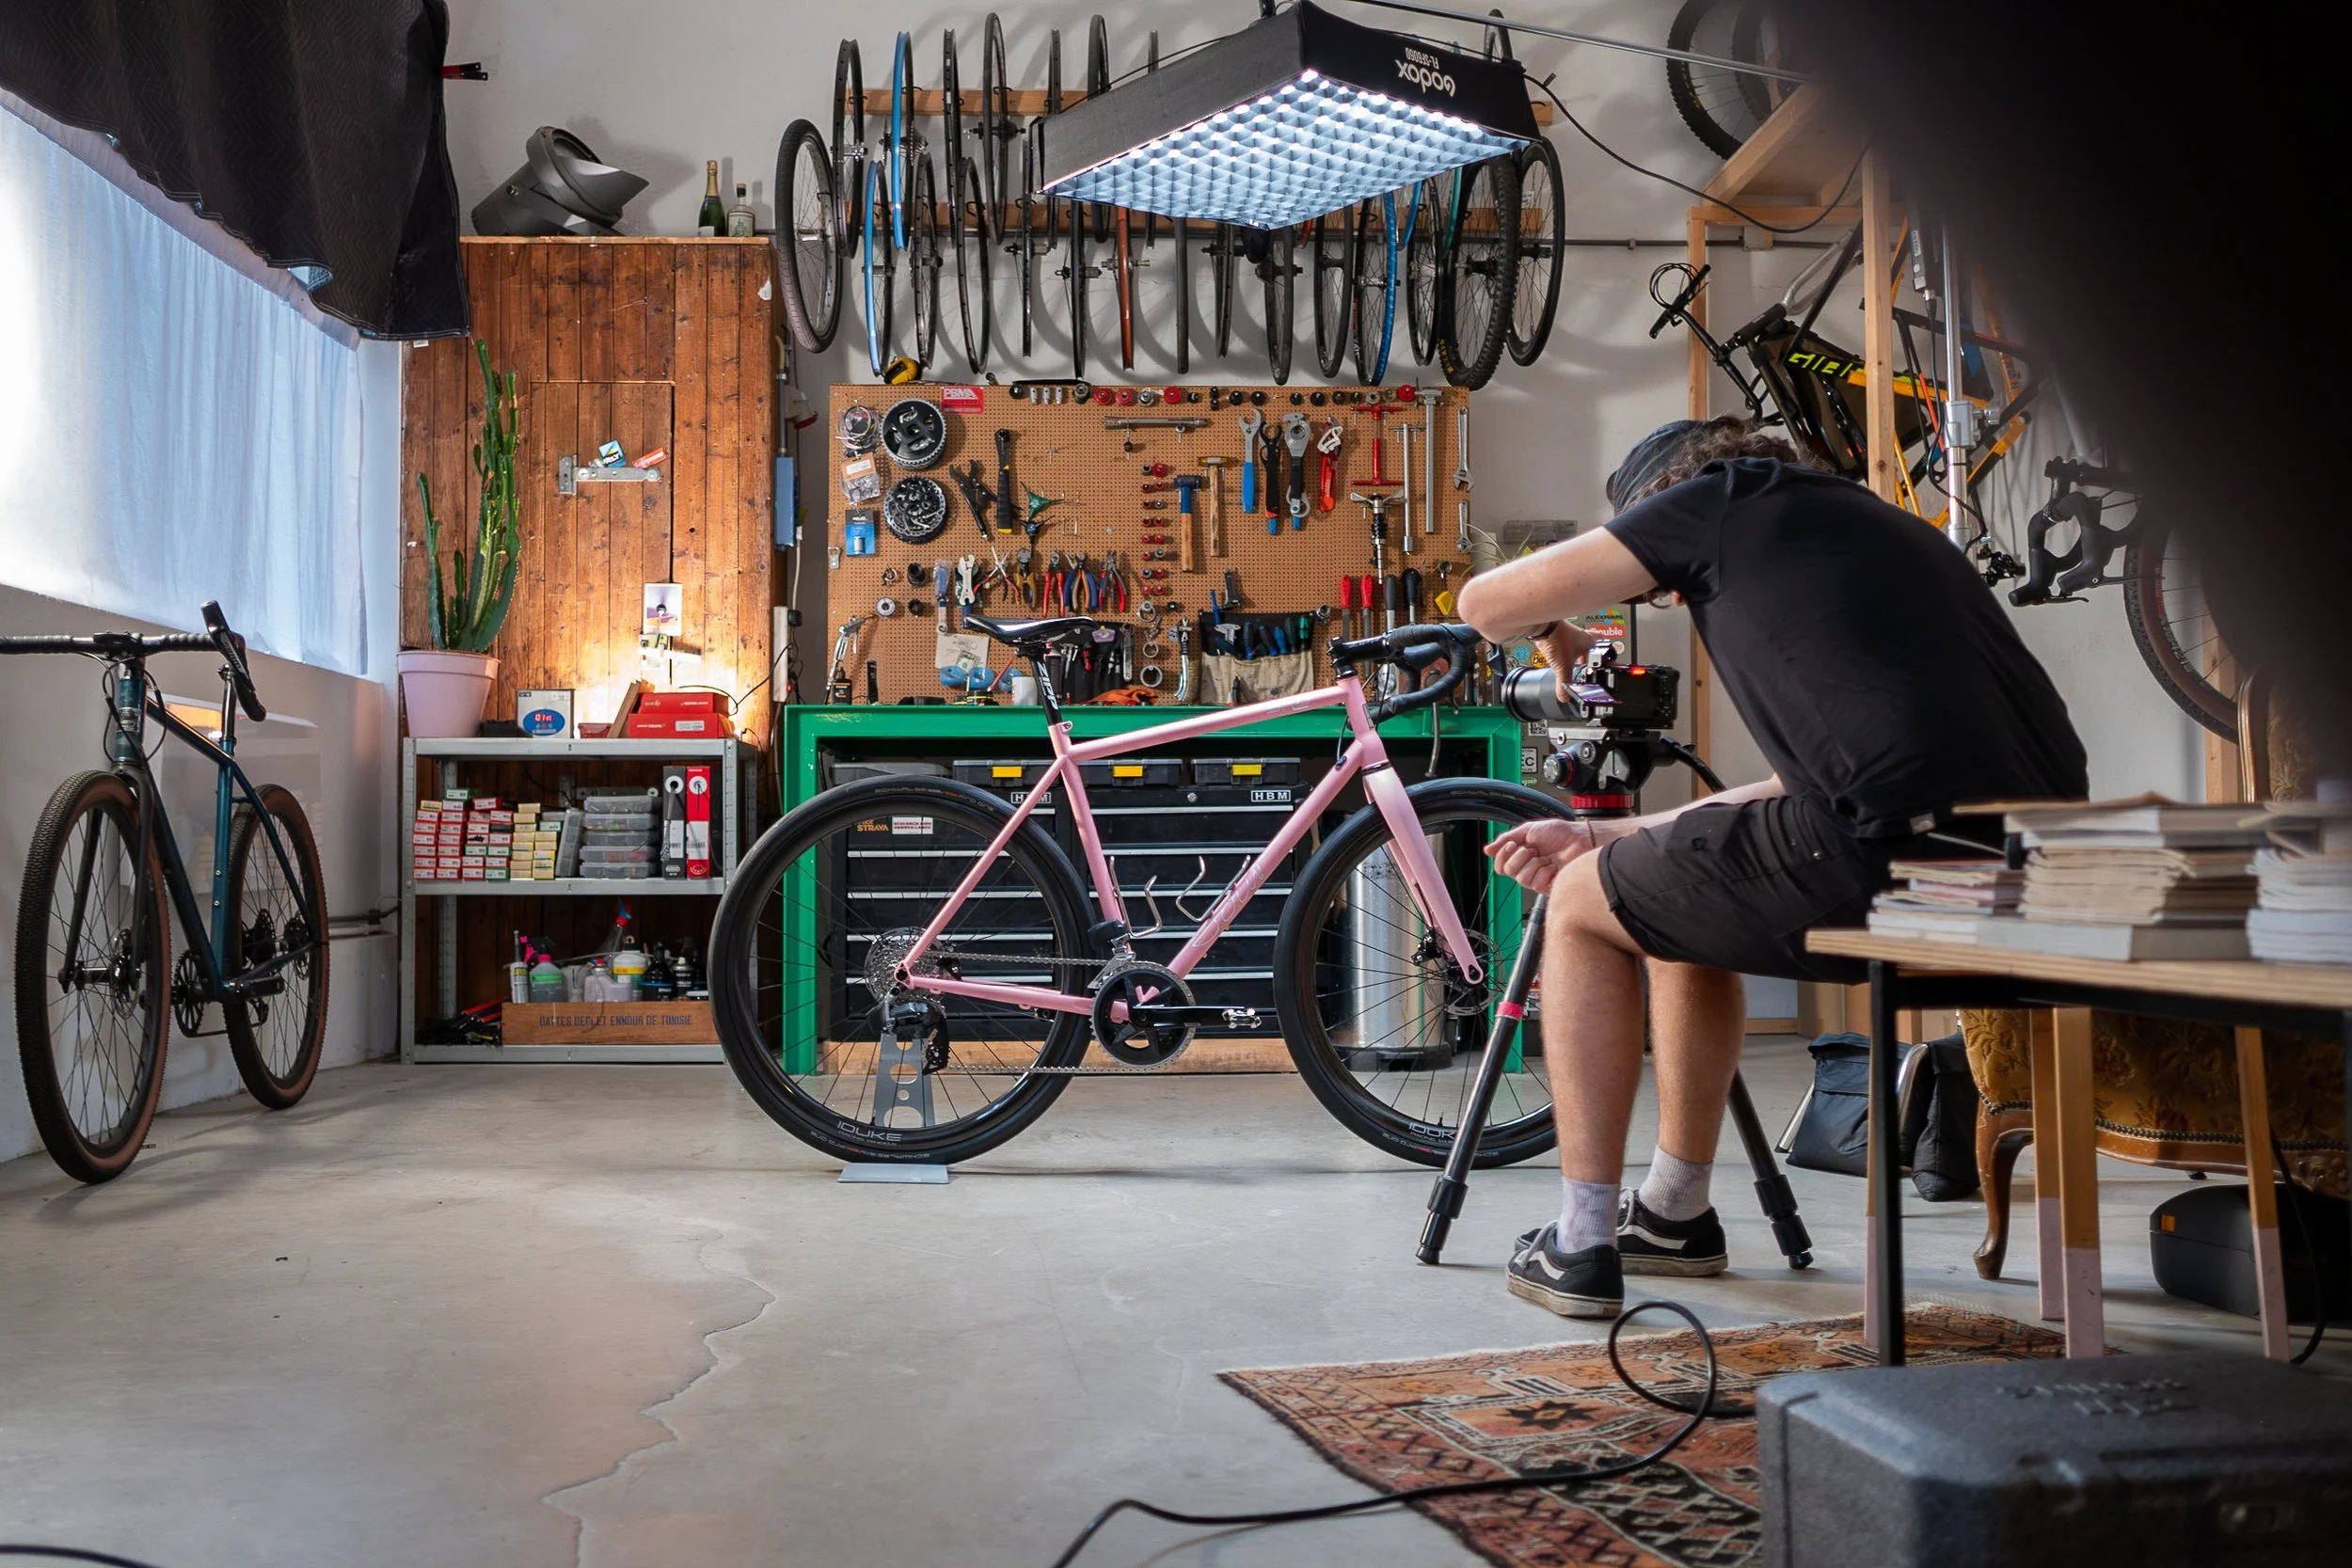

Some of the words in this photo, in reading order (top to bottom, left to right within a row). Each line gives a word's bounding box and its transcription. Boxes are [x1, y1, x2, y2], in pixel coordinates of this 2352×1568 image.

[1589, 626, 1624, 636] Touble
[1037, 661, 1059, 710] ZIPP
[1015, 794, 1048, 802] HM
[1254, 792, 1288, 800] HBM
[539, 1016, 572, 1027] DATTES
[646, 1015, 657, 1025] DE
